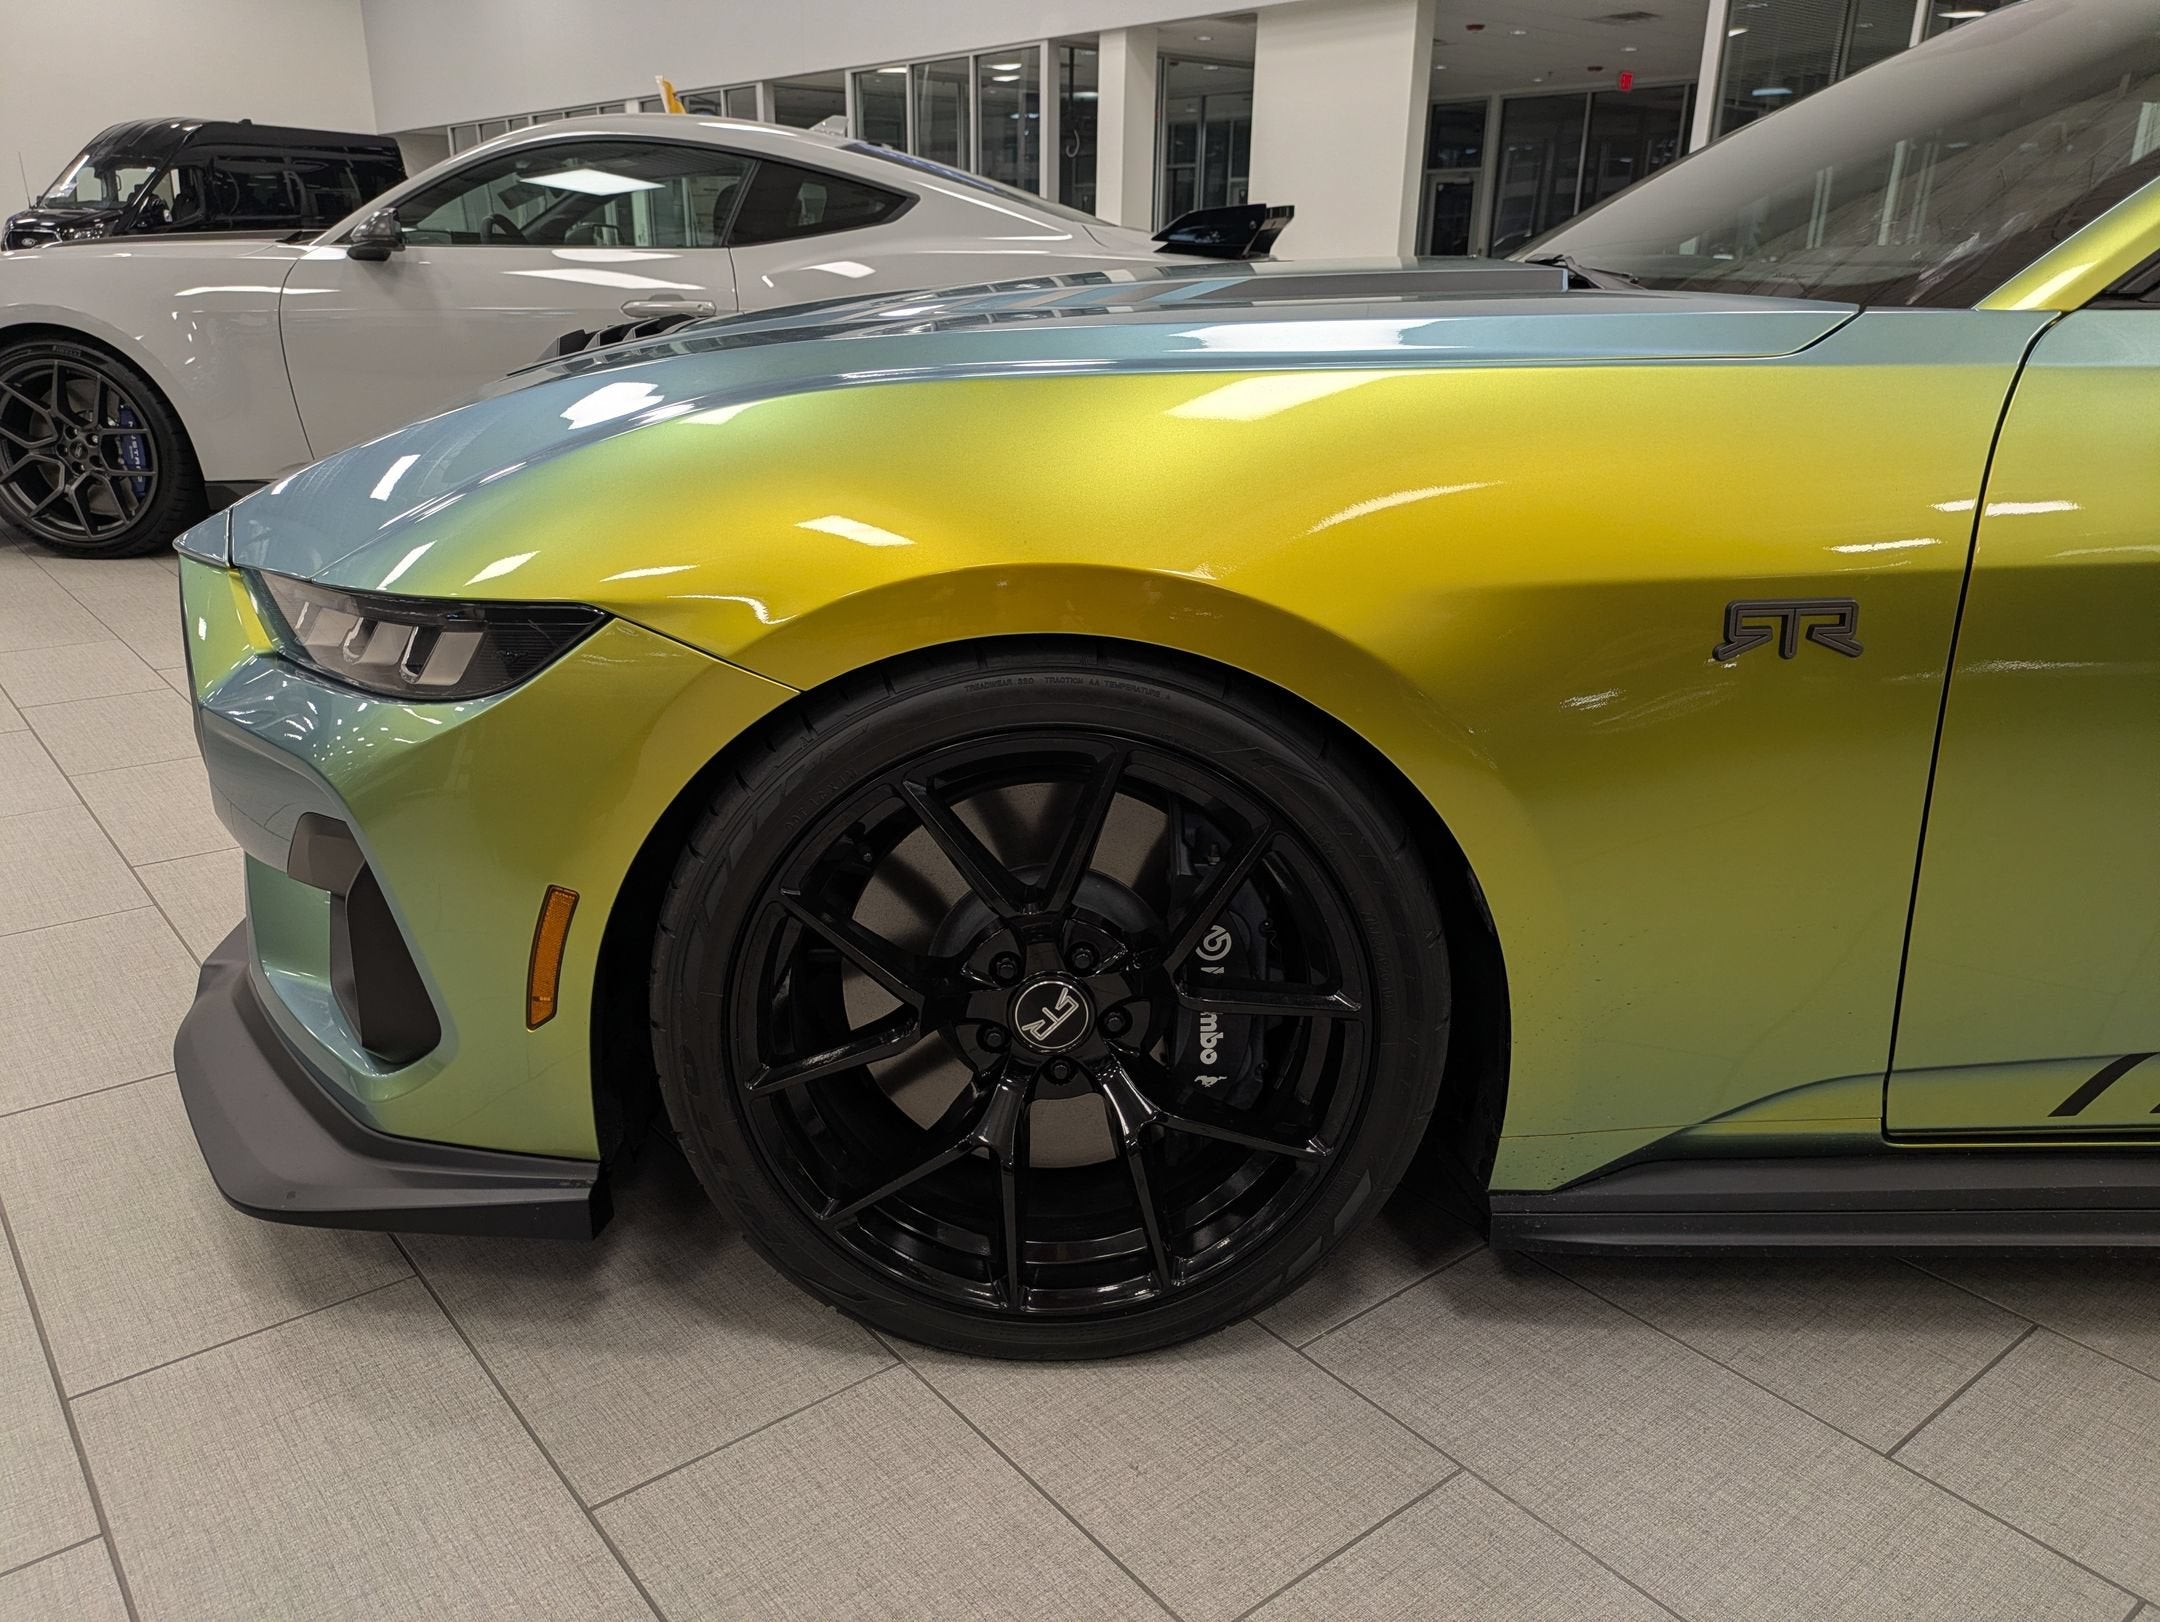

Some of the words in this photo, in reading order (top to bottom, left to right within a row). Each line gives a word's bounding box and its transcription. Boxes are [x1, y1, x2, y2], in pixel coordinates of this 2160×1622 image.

[1712, 597, 1864, 661] RTR
[1044, 676, 1084, 685] TRACTION
[1104, 679, 1161, 697] TEMPERATURE
[1021, 987, 1079, 1040] RTR
